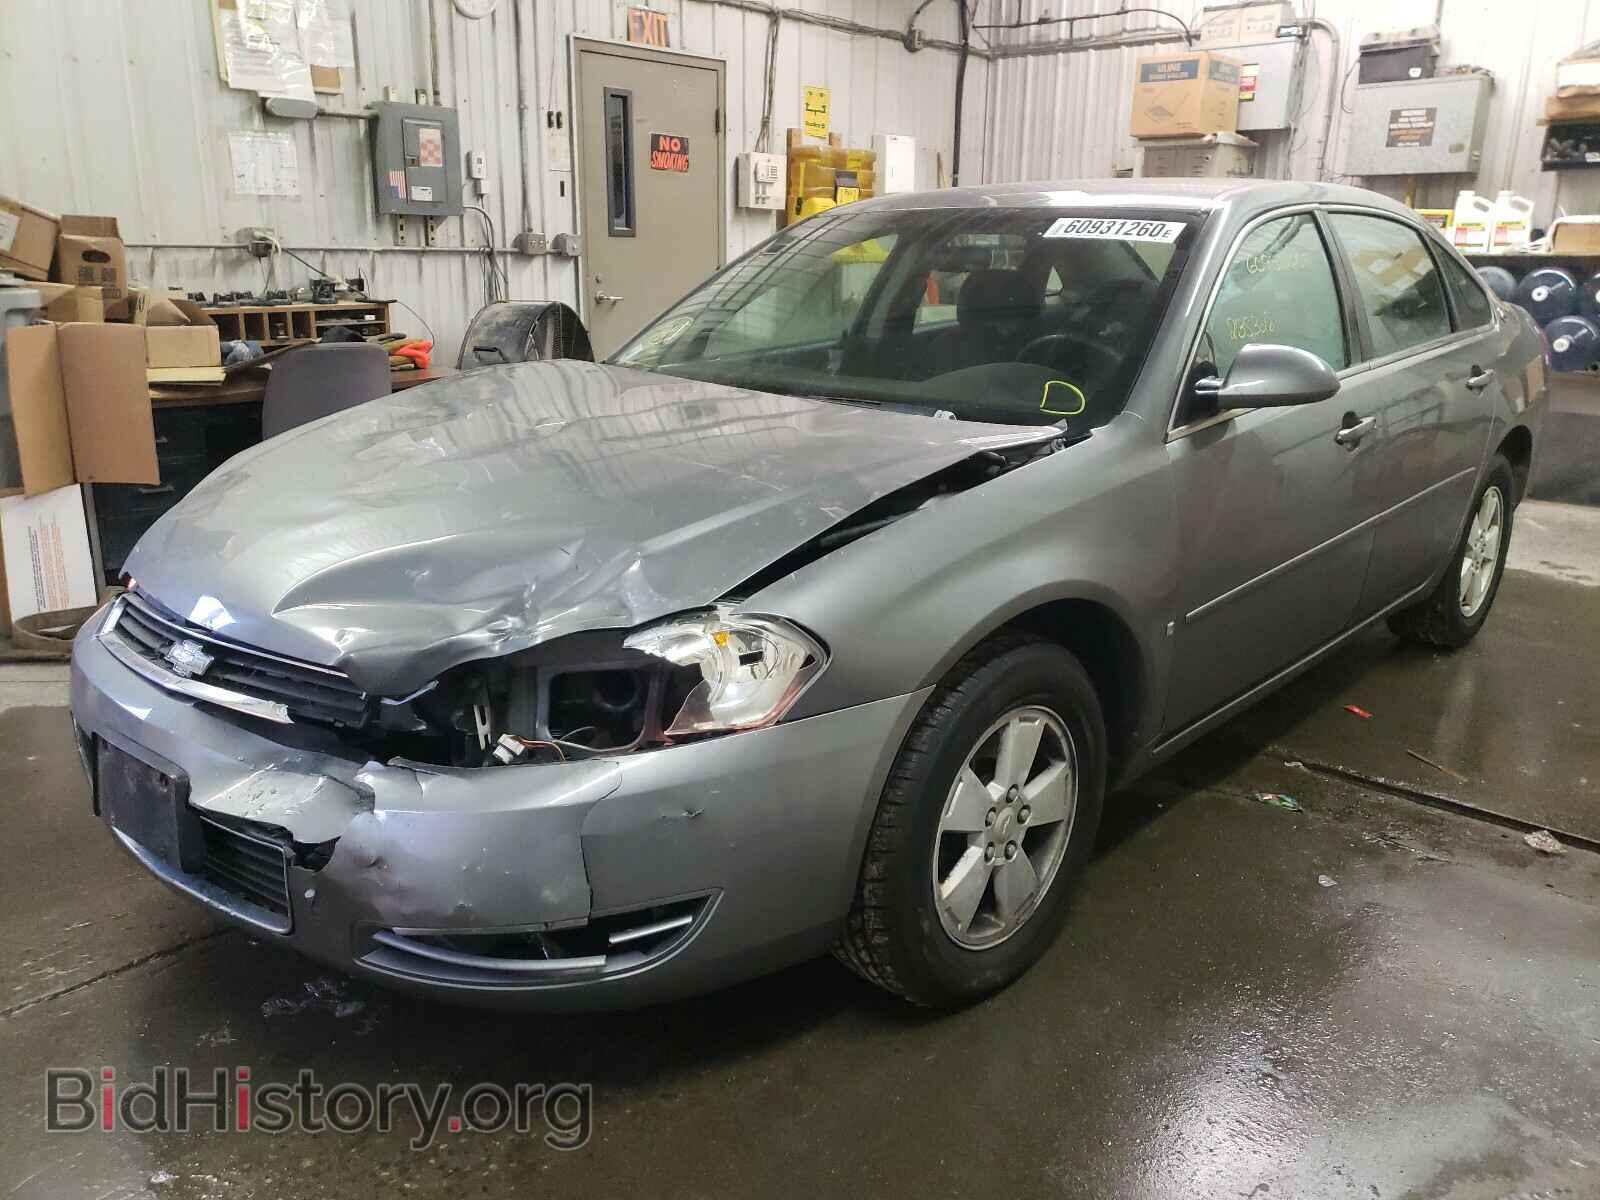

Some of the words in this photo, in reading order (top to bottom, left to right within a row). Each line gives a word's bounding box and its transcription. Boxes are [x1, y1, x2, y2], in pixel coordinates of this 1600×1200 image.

[629, 9, 669, 48] EXIT
[659, 135, 681, 151] NO
[651, 151, 689, 172] SMOKING
